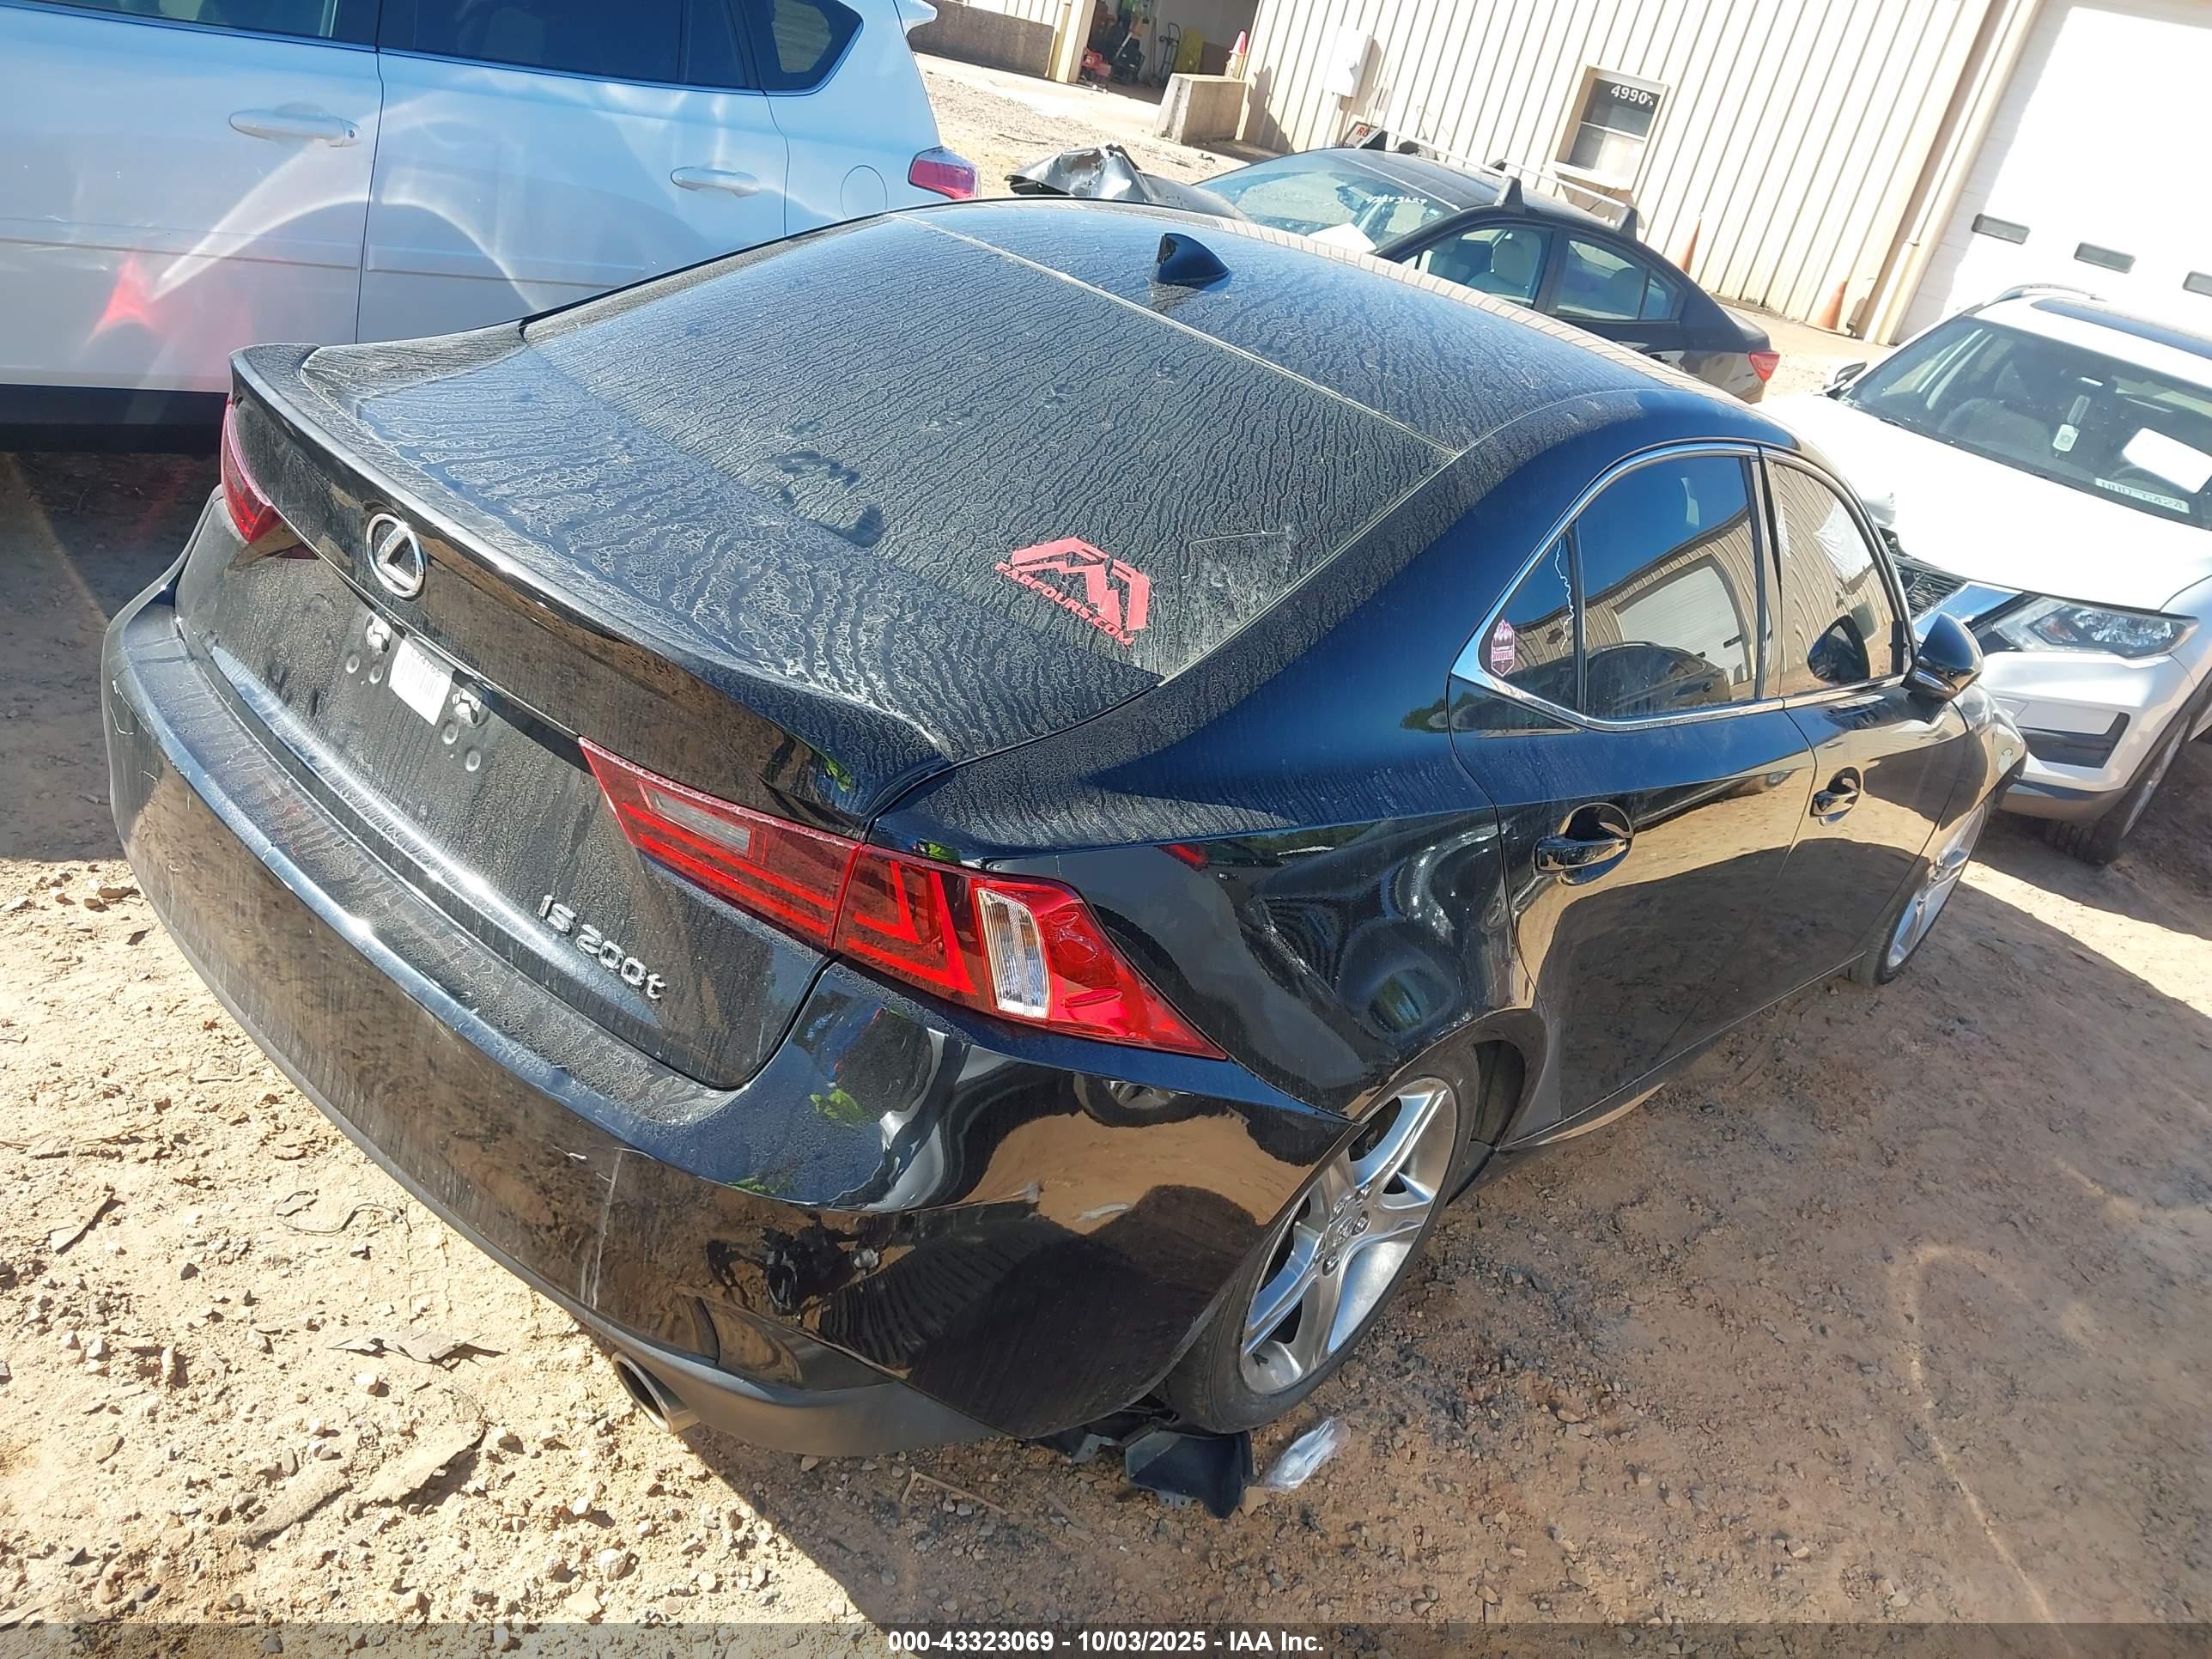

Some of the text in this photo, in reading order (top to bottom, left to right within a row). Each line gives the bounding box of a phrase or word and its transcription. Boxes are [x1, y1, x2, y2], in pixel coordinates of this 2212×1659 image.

[994, 561, 1135, 647] FABFOURS.COM
[538, 895, 666, 999] IS 200t
